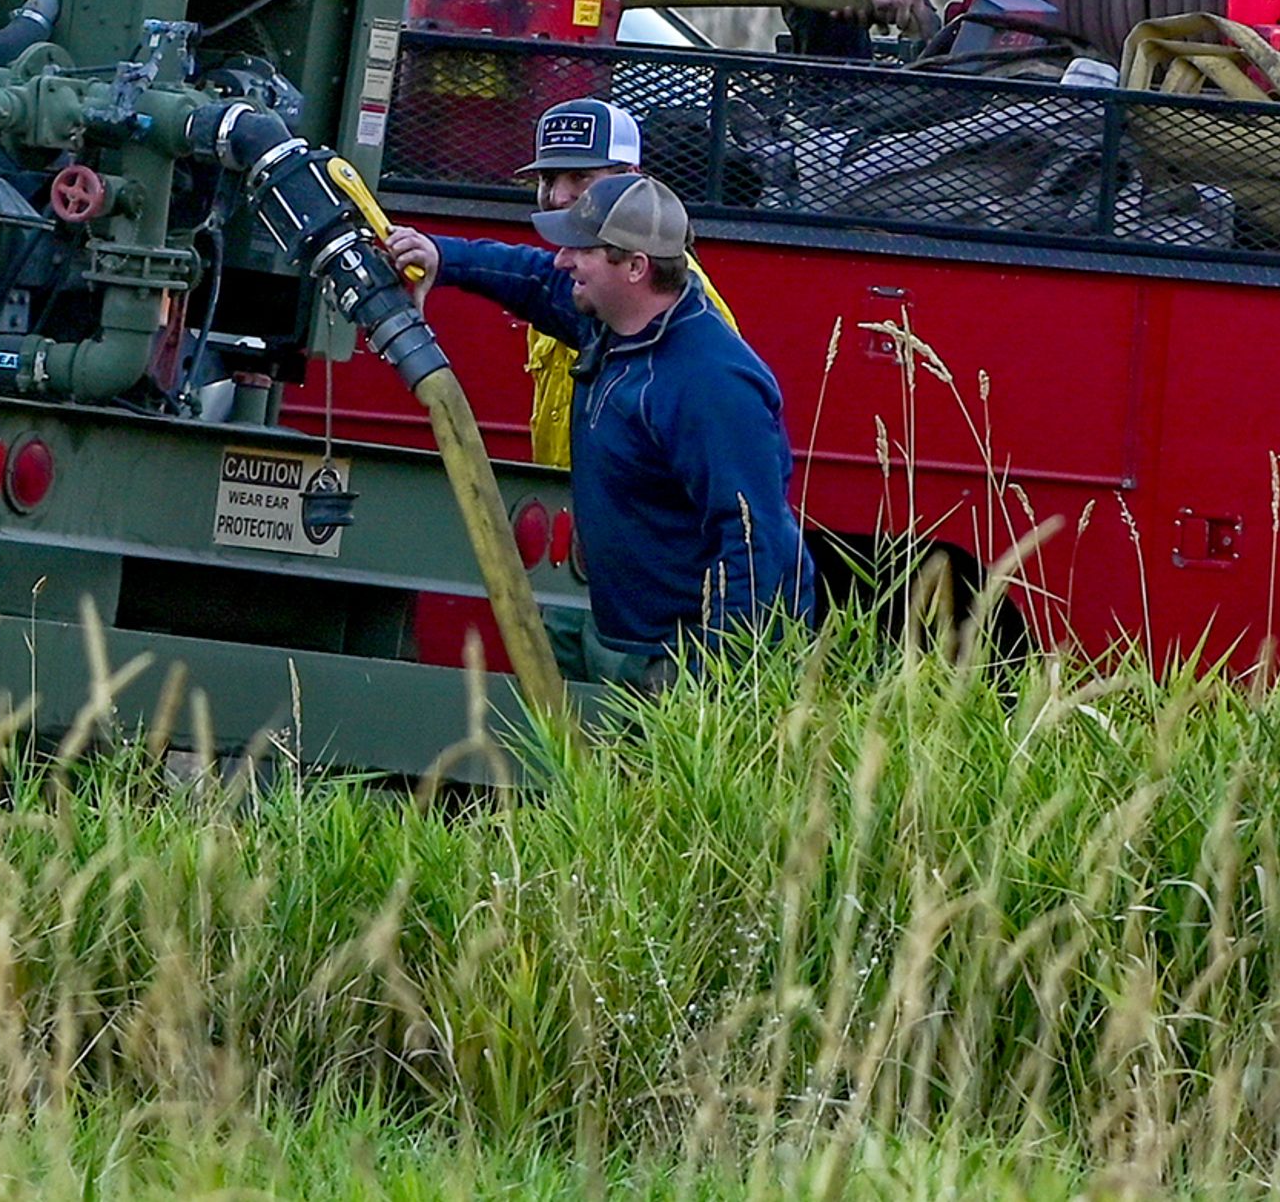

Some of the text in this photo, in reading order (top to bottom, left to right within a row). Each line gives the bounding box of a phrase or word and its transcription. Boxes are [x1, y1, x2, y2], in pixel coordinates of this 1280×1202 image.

[224, 457, 301, 485] CAUTION
[228, 490, 290, 510] WEAR EAR
[217, 515, 294, 541] PROTECTION
